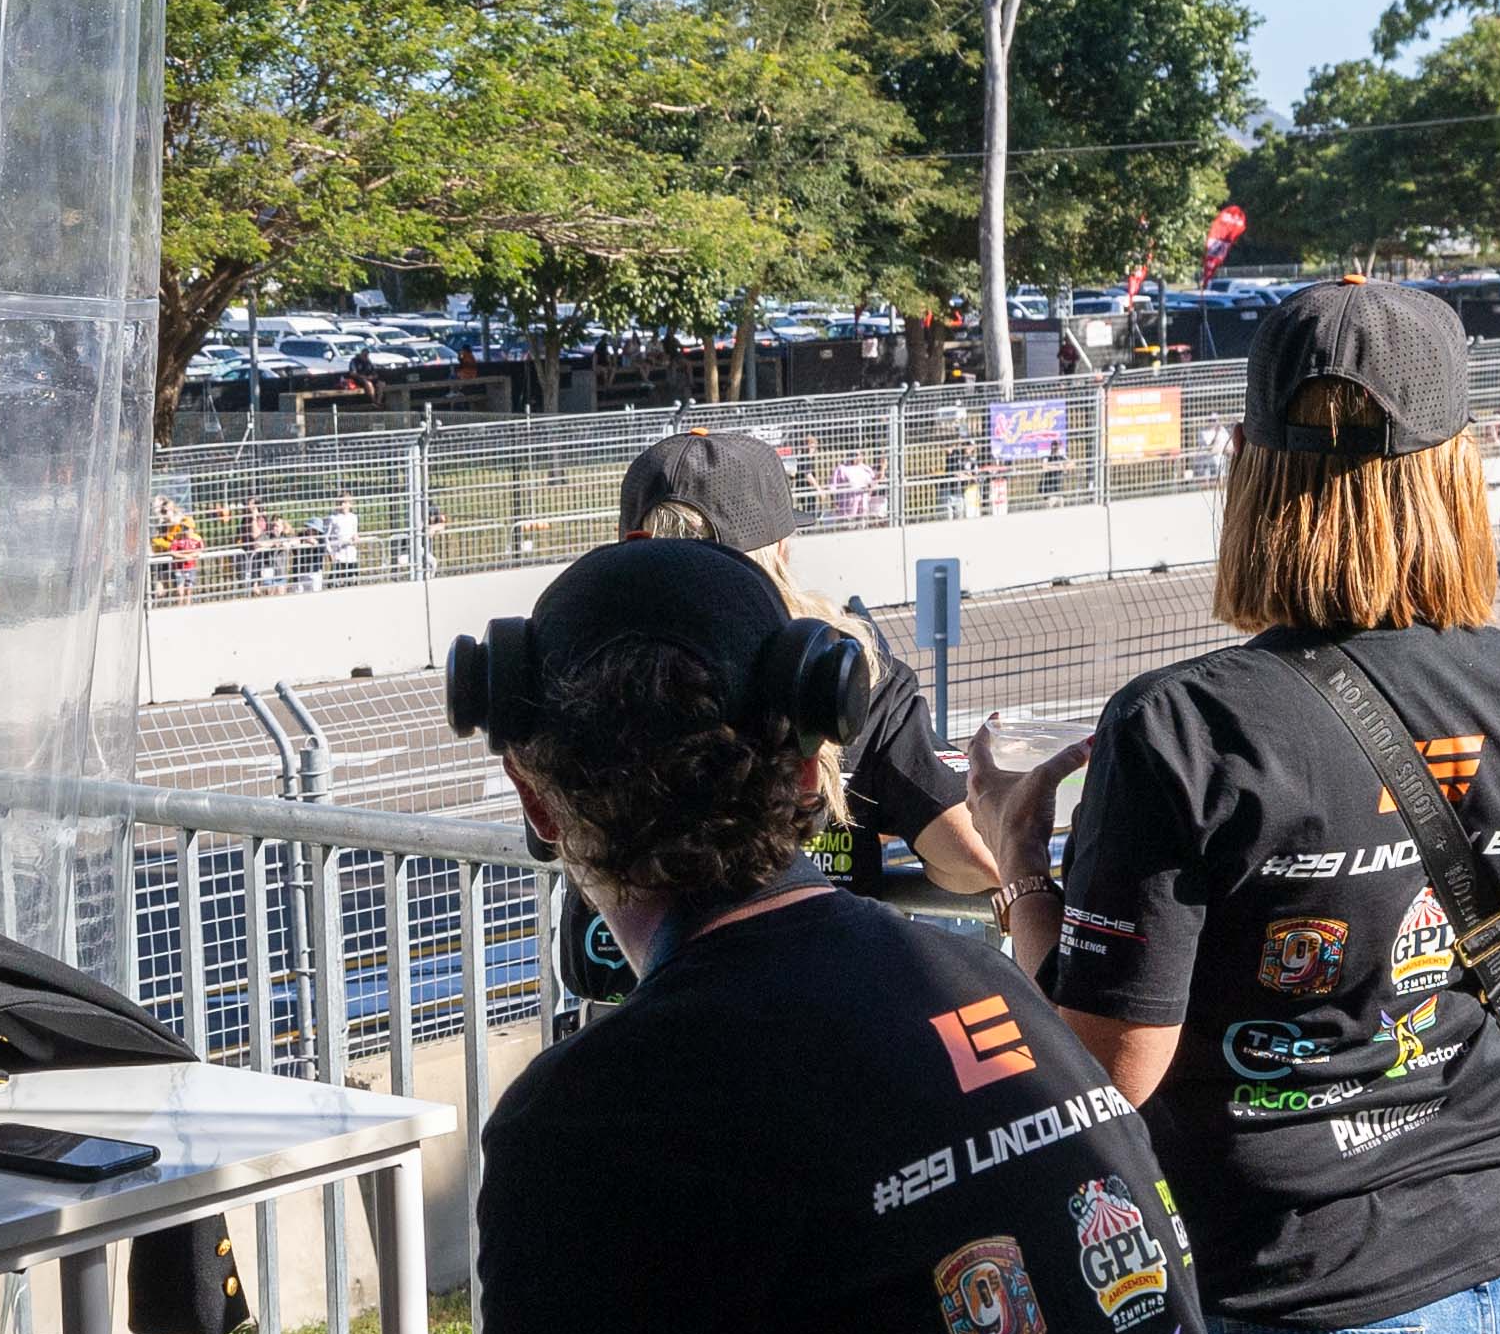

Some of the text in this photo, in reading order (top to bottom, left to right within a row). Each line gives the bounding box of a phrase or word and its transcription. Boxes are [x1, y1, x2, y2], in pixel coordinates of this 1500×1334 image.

[804, 832, 853, 852] OMO
[1262, 852, 1346, 877] #29
[873, 1085, 1137, 1215] #29 LINCOLN EVA
[1083, 1225, 1163, 1289] GPL
[1108, 1275, 1159, 1305] AMUSEMENTS
